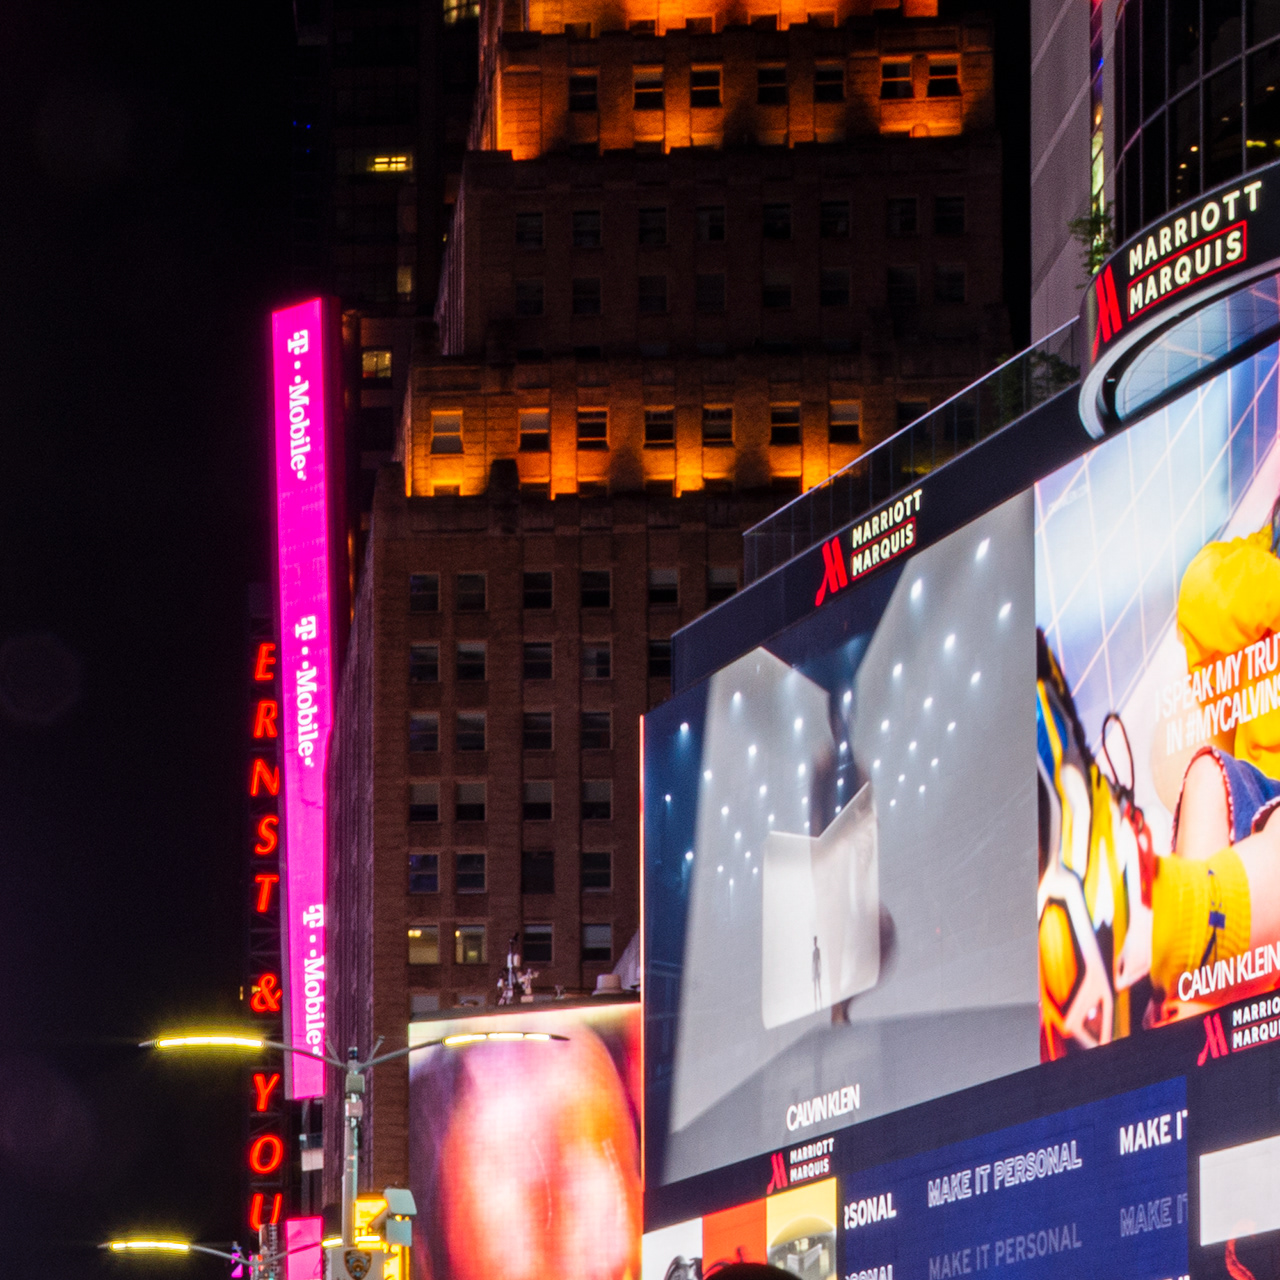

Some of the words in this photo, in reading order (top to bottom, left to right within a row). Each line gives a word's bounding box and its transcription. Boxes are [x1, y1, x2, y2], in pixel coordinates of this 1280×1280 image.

[1128, 180, 1263, 276] MARRIOTT
[1129, 230, 1243, 316] MARQUIS
[852, 489, 922, 548] MARRIOTT
[851, 523, 915, 577] MARQUIS
[1162, 663, 1215, 719] SPEAK
[1215, 650, 1243, 695] MY
[1244, 631, 1280, 680] TRU
[249, 642, 281, 913] ERNST
[1177, 956, 1235, 1002] CALVIN
[1236, 941, 1280, 984] KLEIN
[786, 1094, 827, 1132] CALVIN
[828, 1083, 860, 1119] KLEIN
[1119, 1114, 1172, 1156] MAKE
[789, 1137, 835, 1165] MARRIOTT
[789, 1157, 830, 1183] MARQUIS
[927, 1169, 972, 1208] MAKE
[975, 1163, 991, 1196] IT
[993, 1140, 1083, 1191] PERSONAL
[1120, 1197, 1173, 1238] MAKE
[975, 1243, 991, 1272] IT
[994, 1222, 1083, 1267] PERSONAL
